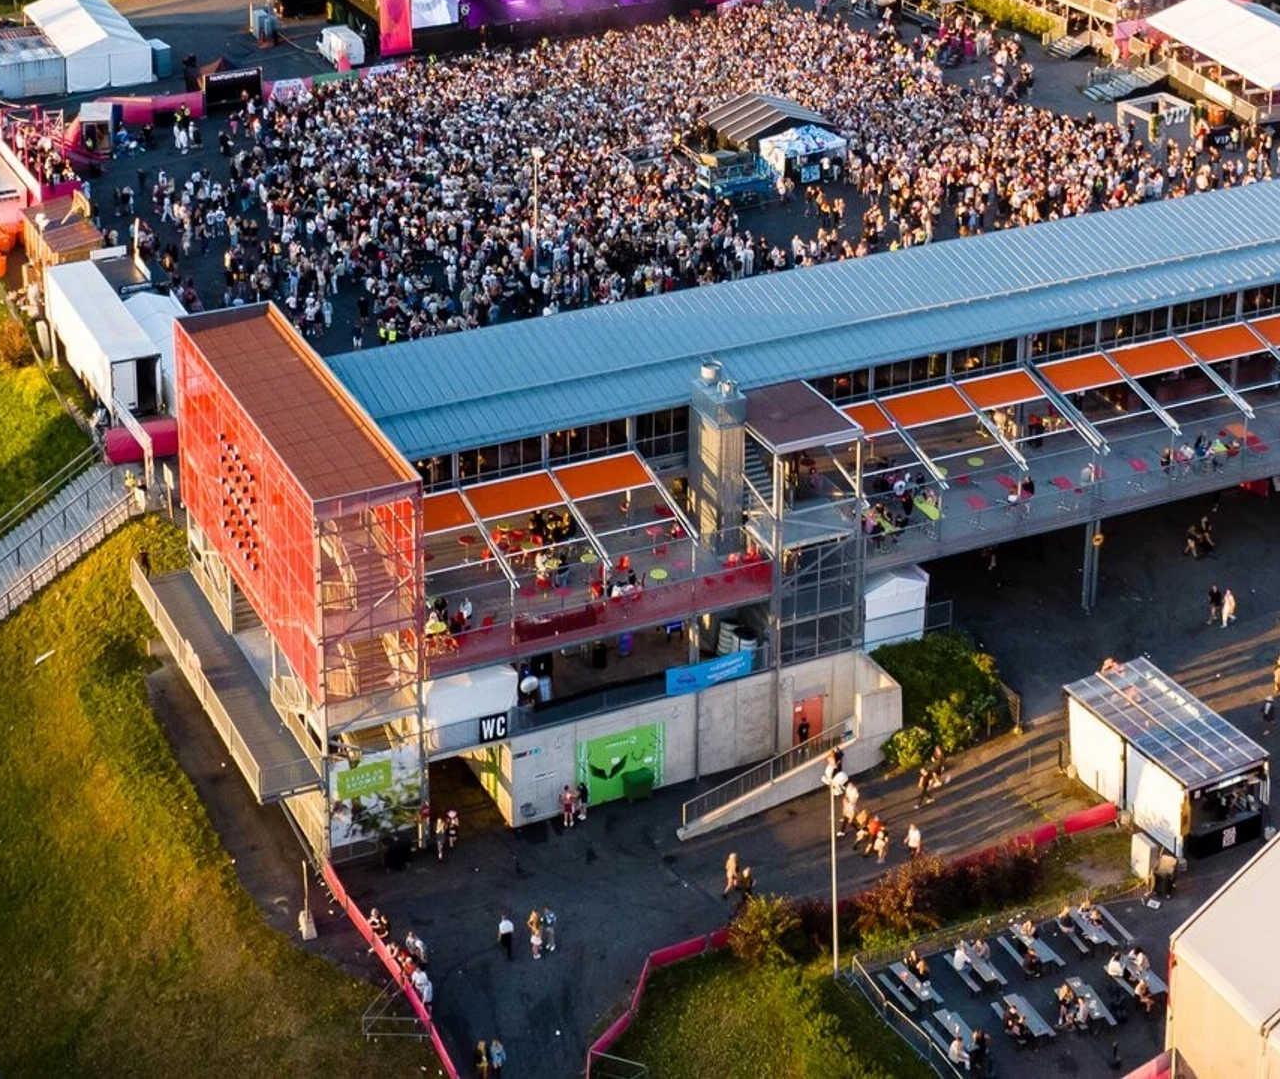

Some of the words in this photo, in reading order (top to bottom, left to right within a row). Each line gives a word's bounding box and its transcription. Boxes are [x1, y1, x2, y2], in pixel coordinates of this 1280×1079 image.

[1162, 106, 1191, 126] VIP
[1214, 135, 1231, 145] VIP
[481, 716, 506, 740] WC
